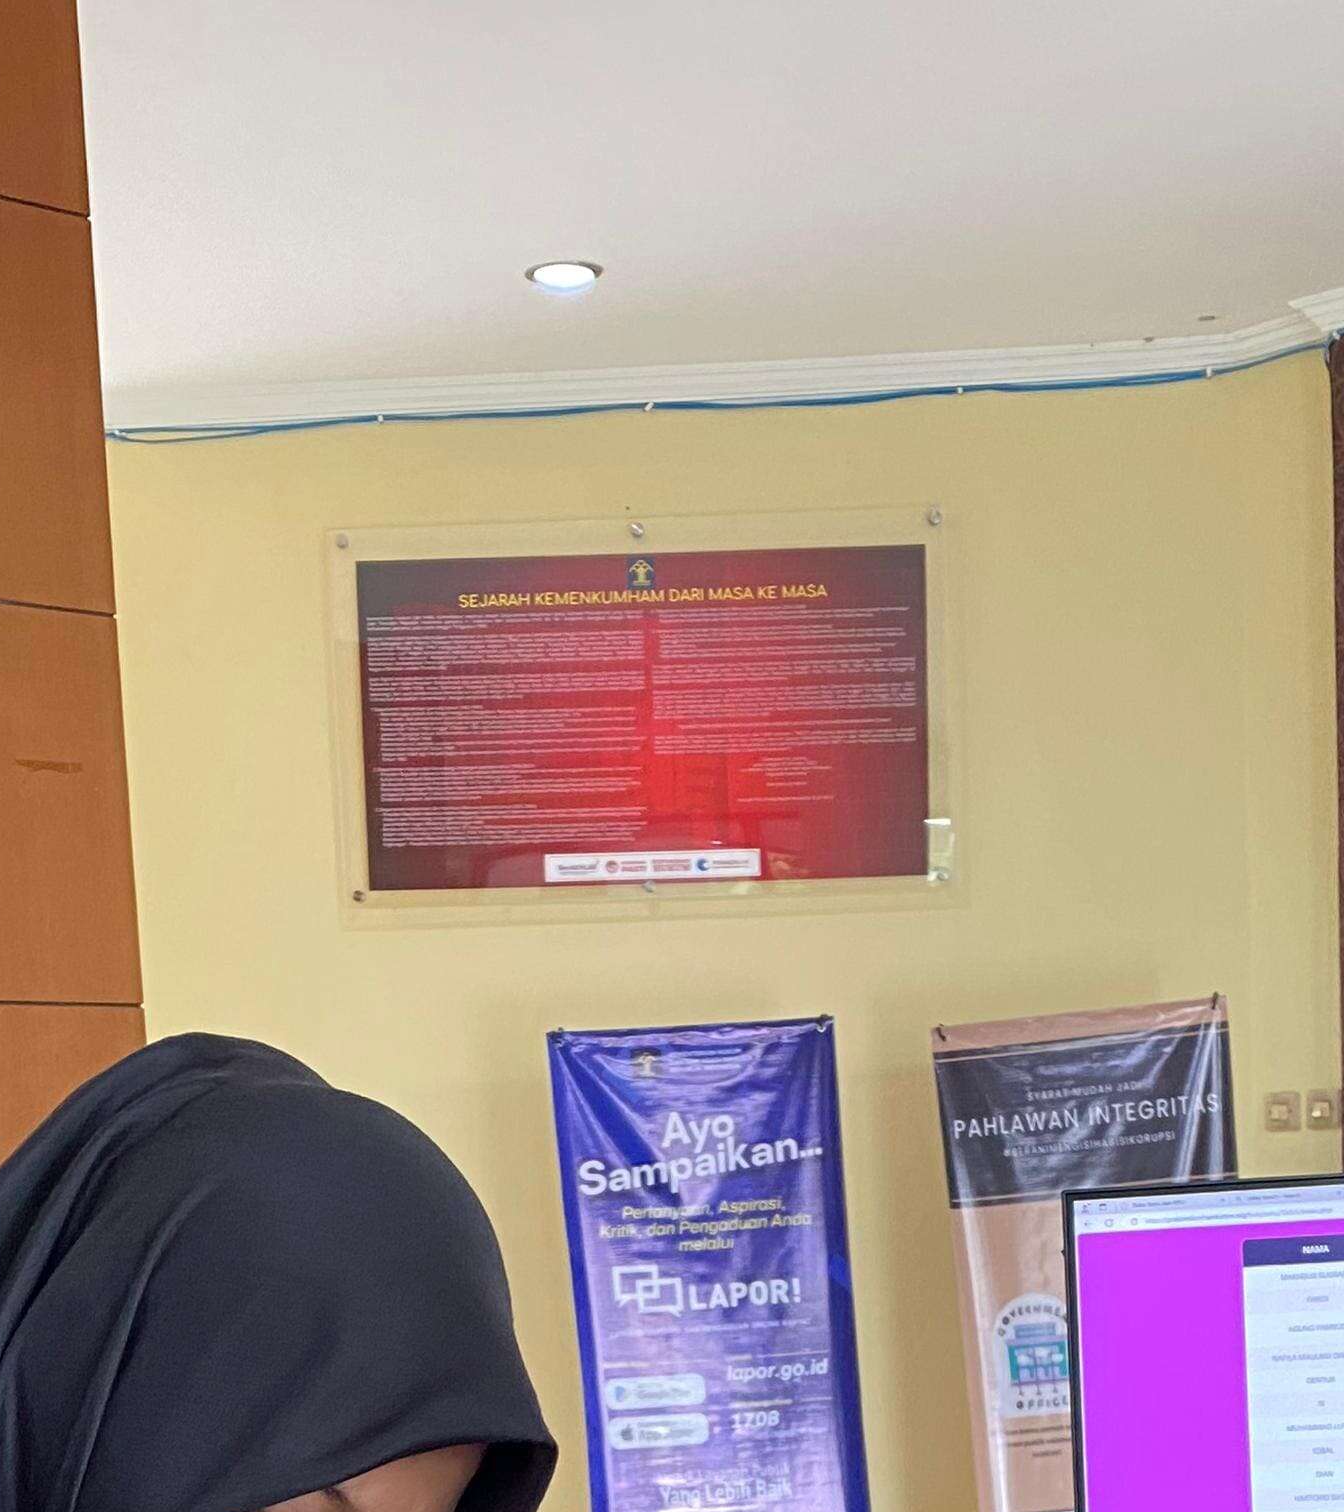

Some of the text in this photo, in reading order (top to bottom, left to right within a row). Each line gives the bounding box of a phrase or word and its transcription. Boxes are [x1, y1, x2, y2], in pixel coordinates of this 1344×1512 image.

[458, 585, 827, 608] SEJARAH KEMENKUMHAM DARI MASA KE MASA
[662, 1112, 735, 1149] Ayo
[954, 1094, 1218, 1140] PAHLAWAN INTEGRITAS
[578, 1135, 823, 1197] Sampaikan...
[647, 1219, 674, 1236] dan
[679, 1218, 768, 1236] Pengaduan
[771, 1213, 811, 1228] Anda
[678, 1238, 735, 1251] melalui
[688, 1279, 802, 1311] LAPOR!
[726, 1358, 829, 1382] lapor.go.id
